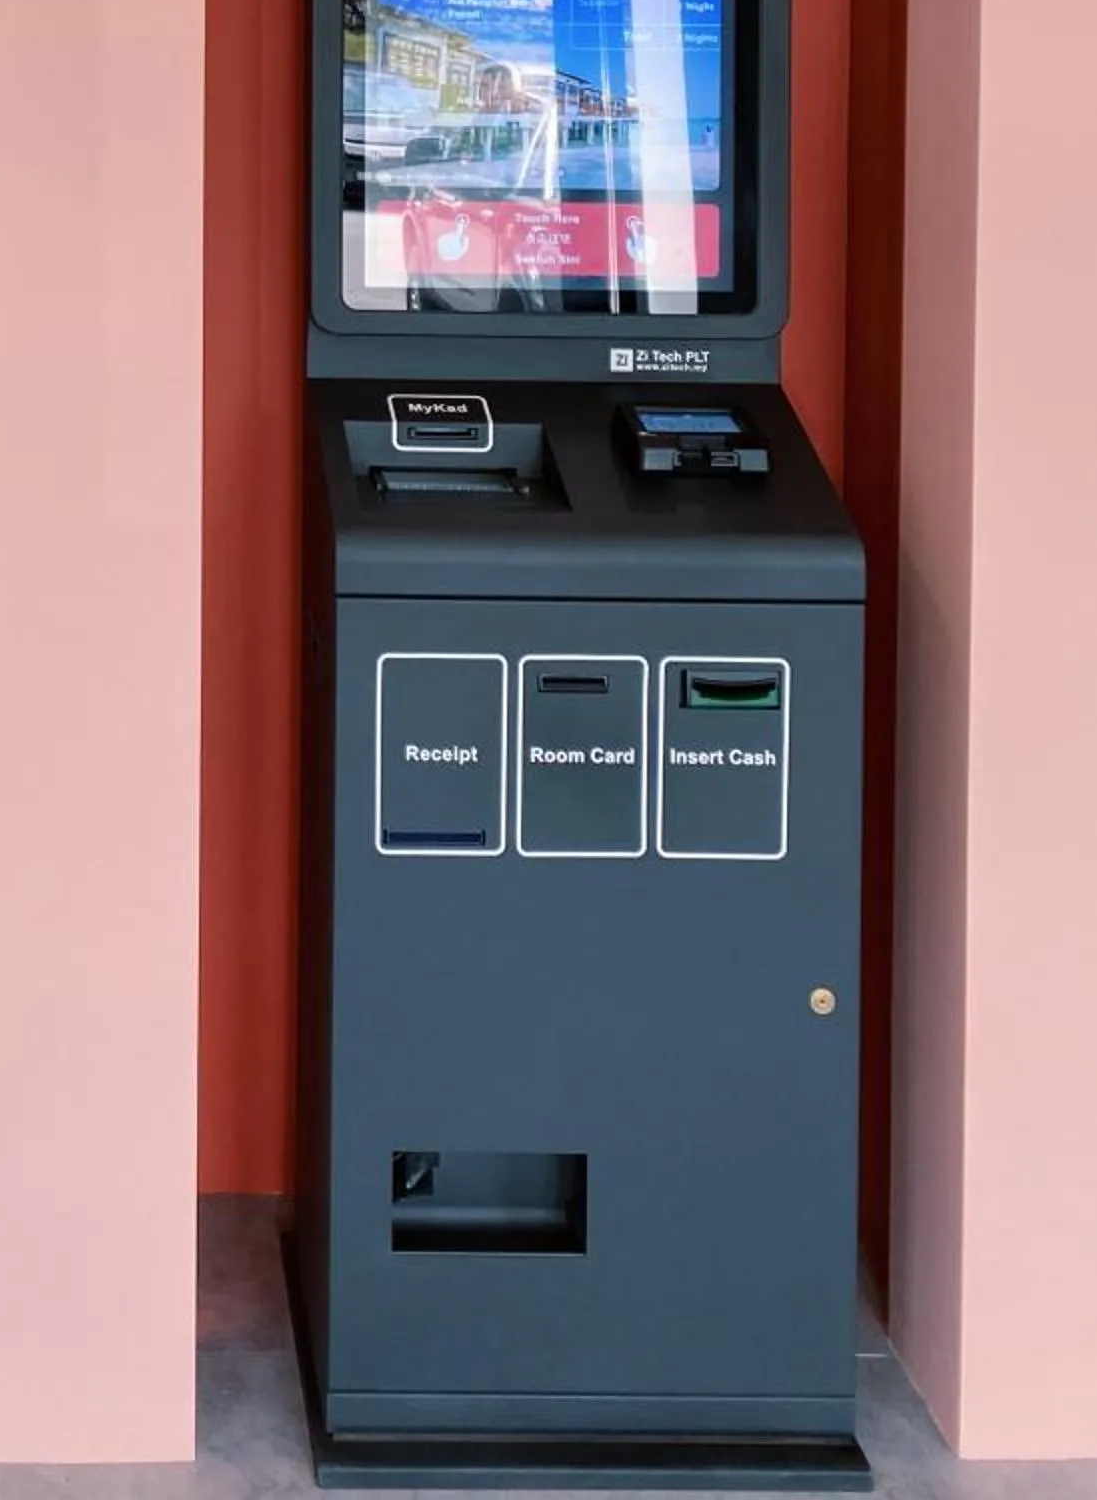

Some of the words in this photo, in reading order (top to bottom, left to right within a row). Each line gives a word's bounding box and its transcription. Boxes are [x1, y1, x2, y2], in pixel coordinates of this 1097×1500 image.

[651, 349, 682, 362] Tech
[686, 351, 710, 363] PLT
[407, 403, 469, 414] MyKad
[405, 744, 479, 765] Receipt
[529, 746, 586, 764] Room
[590, 746, 636, 765] Card
[669, 747, 724, 766] Insert
[728, 748, 777, 767] Cash
